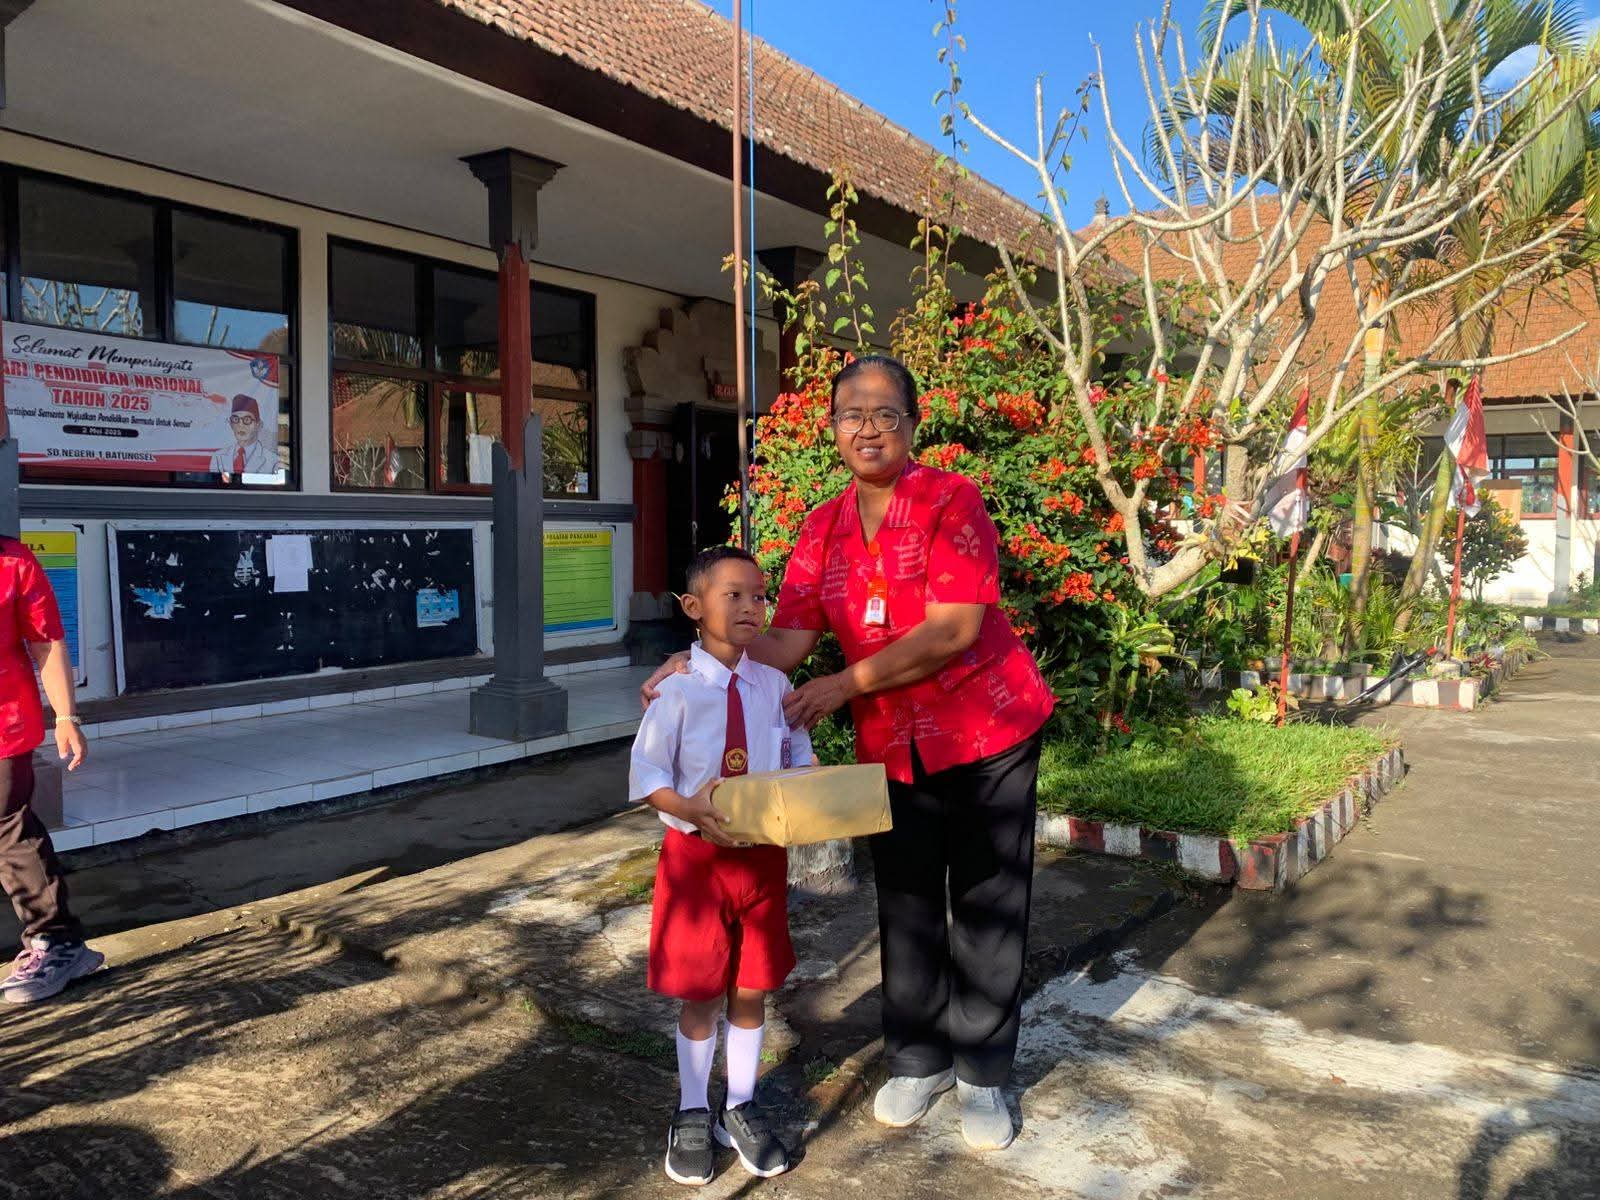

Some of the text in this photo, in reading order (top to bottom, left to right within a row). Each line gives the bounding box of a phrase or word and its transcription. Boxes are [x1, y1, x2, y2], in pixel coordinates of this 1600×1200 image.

[12, 334, 193, 374] Selamat Memperingati
[3, 360, 203, 394] ARI PENDIDIKAN NASIONAL
[52, 388, 150, 411] TAHUN 2025
[104, 428, 122, 436] 2025
[105, 450, 153, 461] BATUNGSEL
